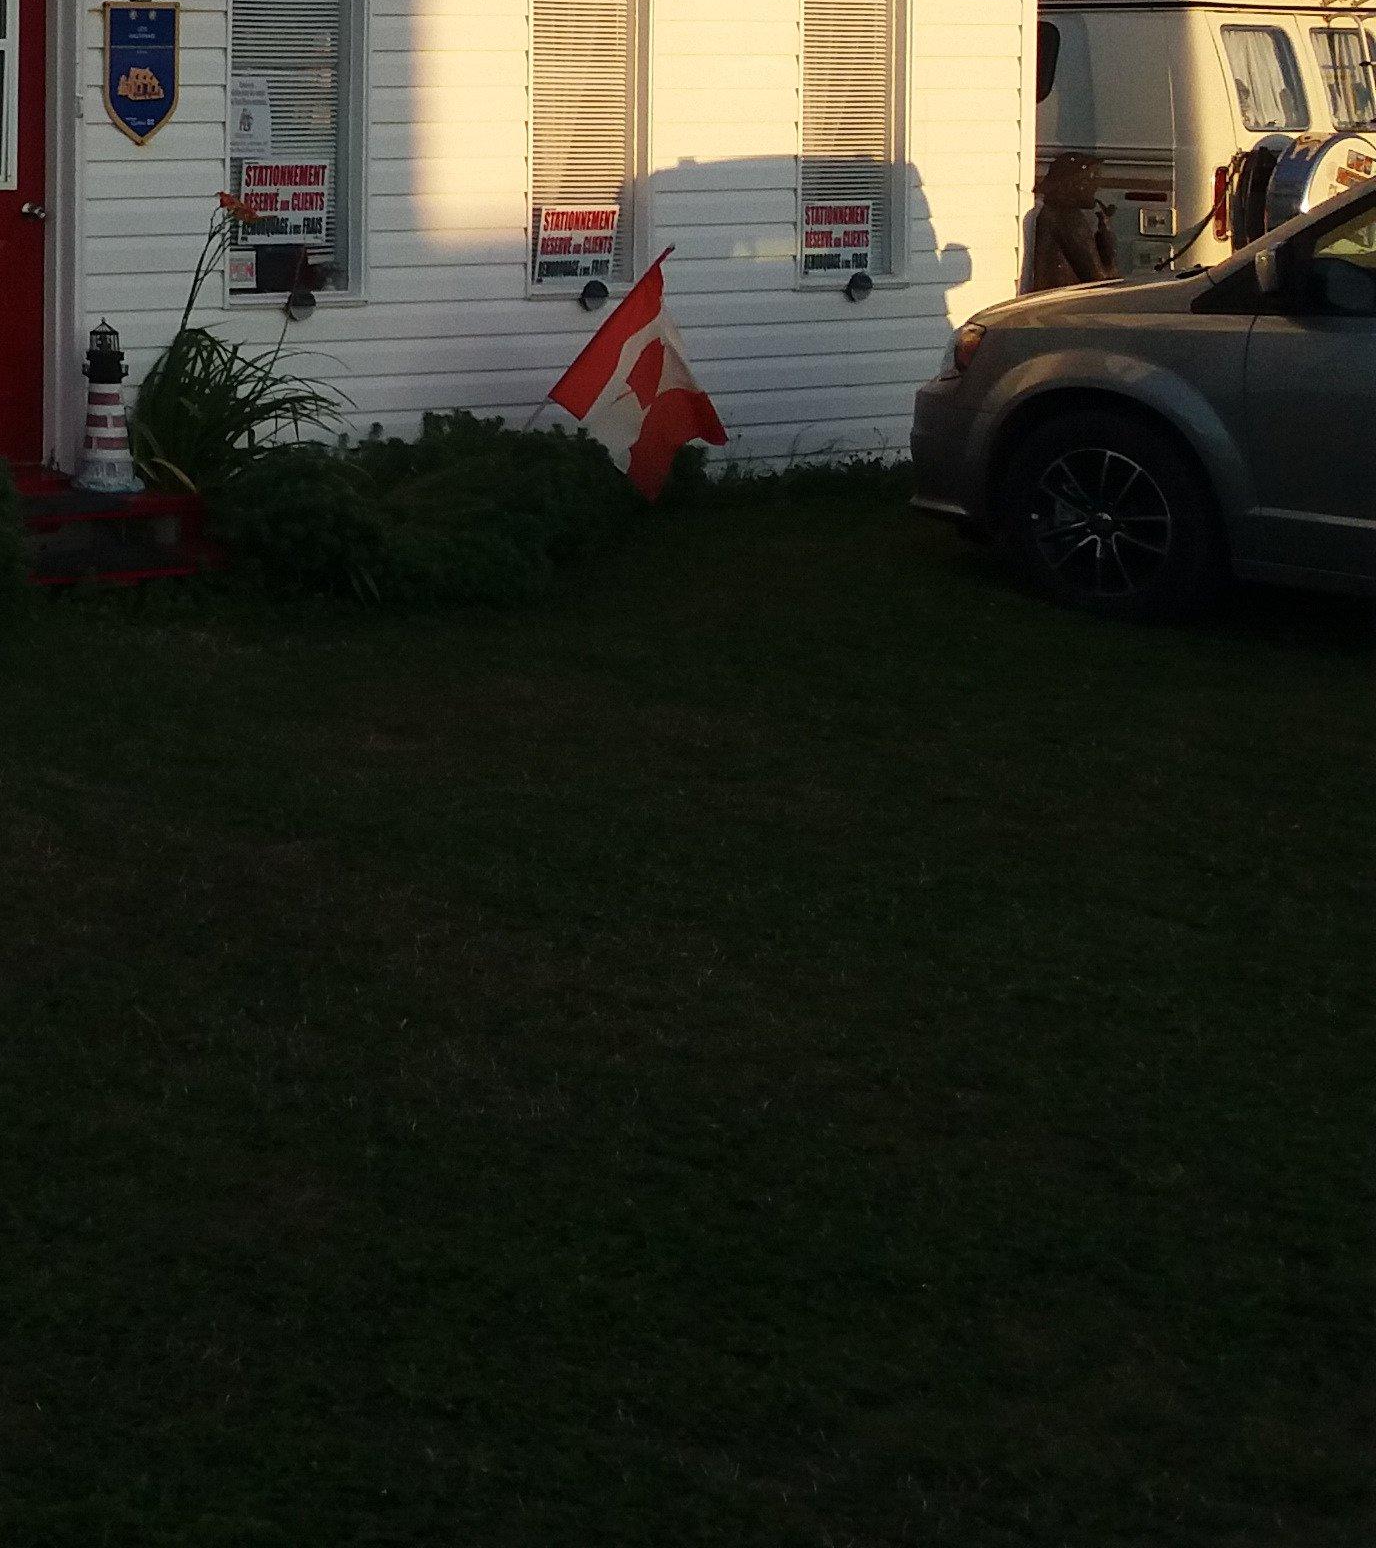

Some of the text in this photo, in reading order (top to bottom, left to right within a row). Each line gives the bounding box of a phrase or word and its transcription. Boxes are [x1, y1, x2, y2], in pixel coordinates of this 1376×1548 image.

[244, 164, 327, 187] STATIONNEMENT
[291, 192, 325, 211] CLIENTS
[543, 210, 617, 231] STATIONNEMENT
